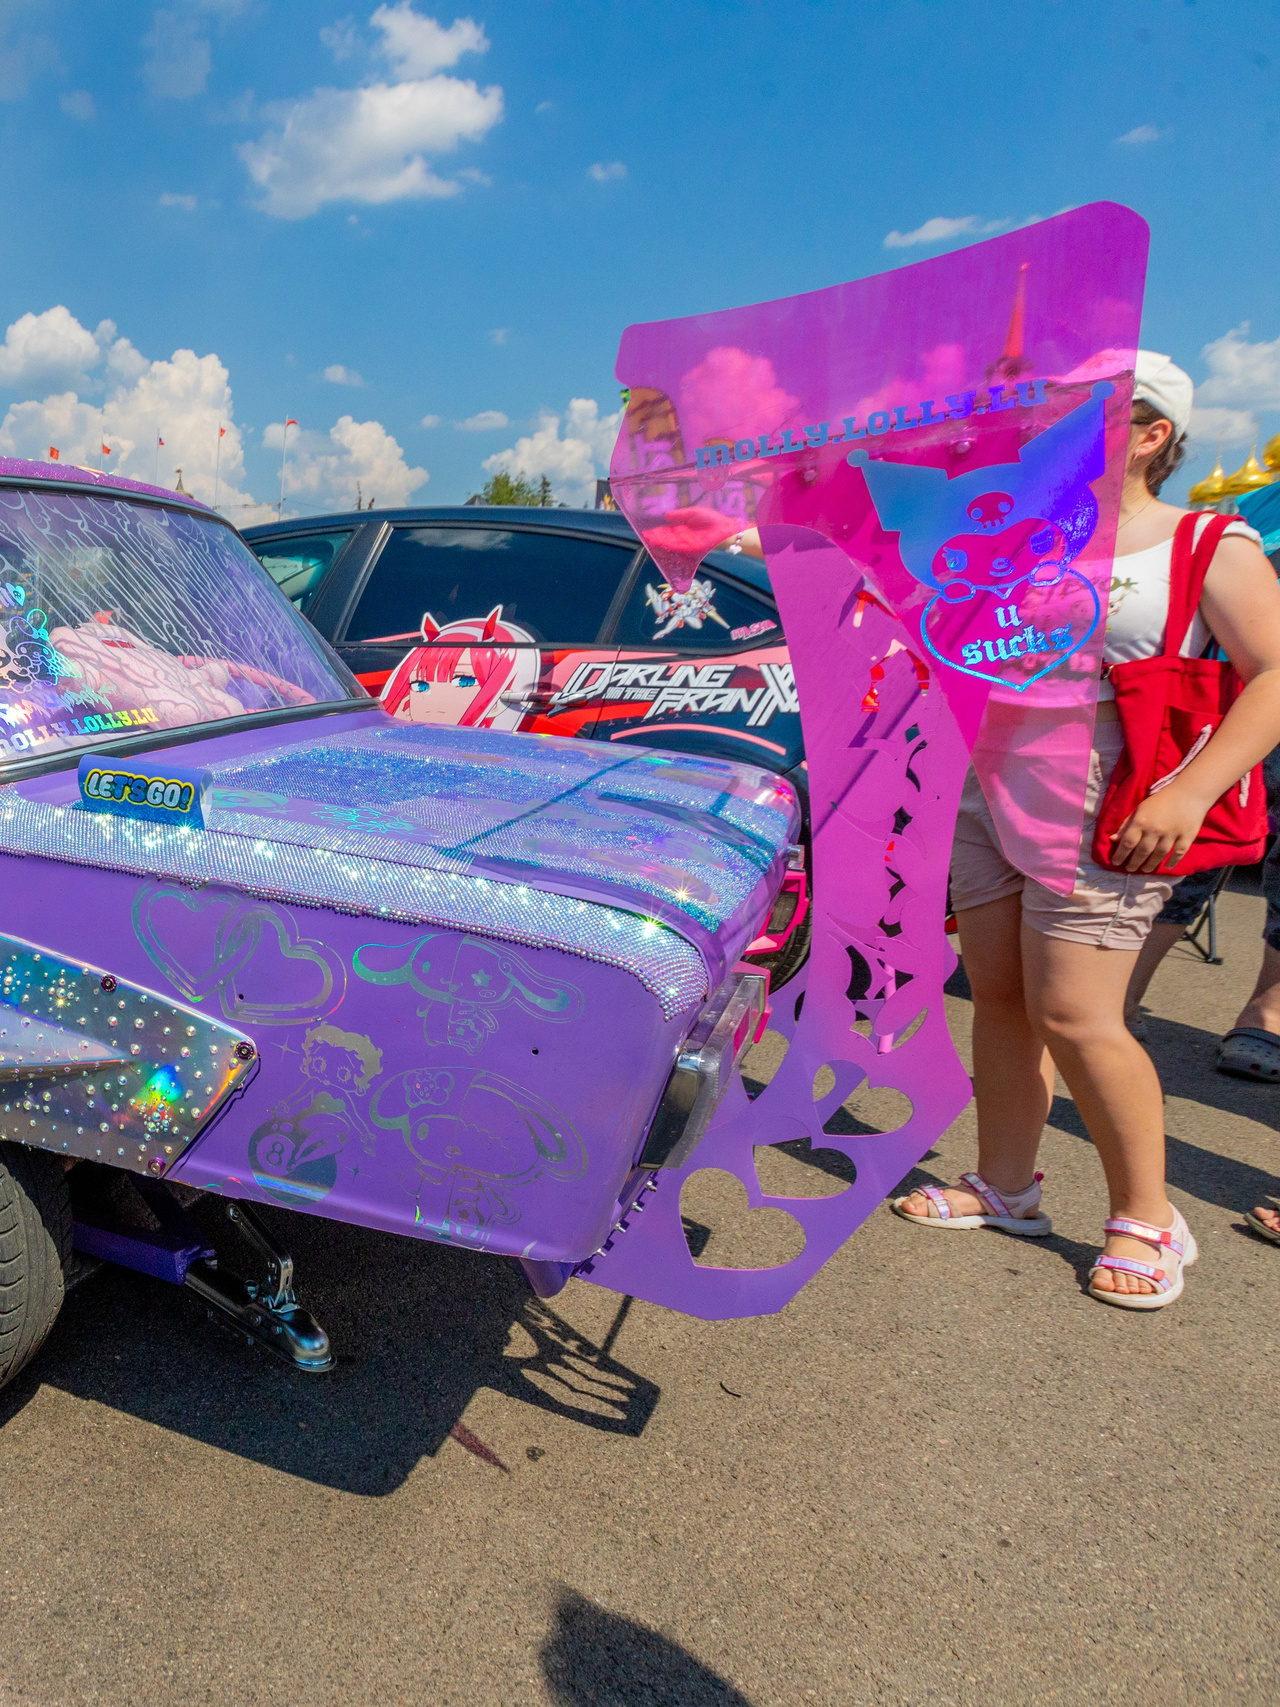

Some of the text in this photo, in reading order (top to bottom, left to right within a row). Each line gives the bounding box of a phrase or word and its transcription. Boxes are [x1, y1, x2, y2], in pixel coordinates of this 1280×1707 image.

[961, 623, 1074, 666] sucks
[546, 662, 738, 717] DARLING
[621, 688, 657, 700] THE
[87, 772, 193, 811] LET'S GO!
[267, 1141, 285, 1167] 8
